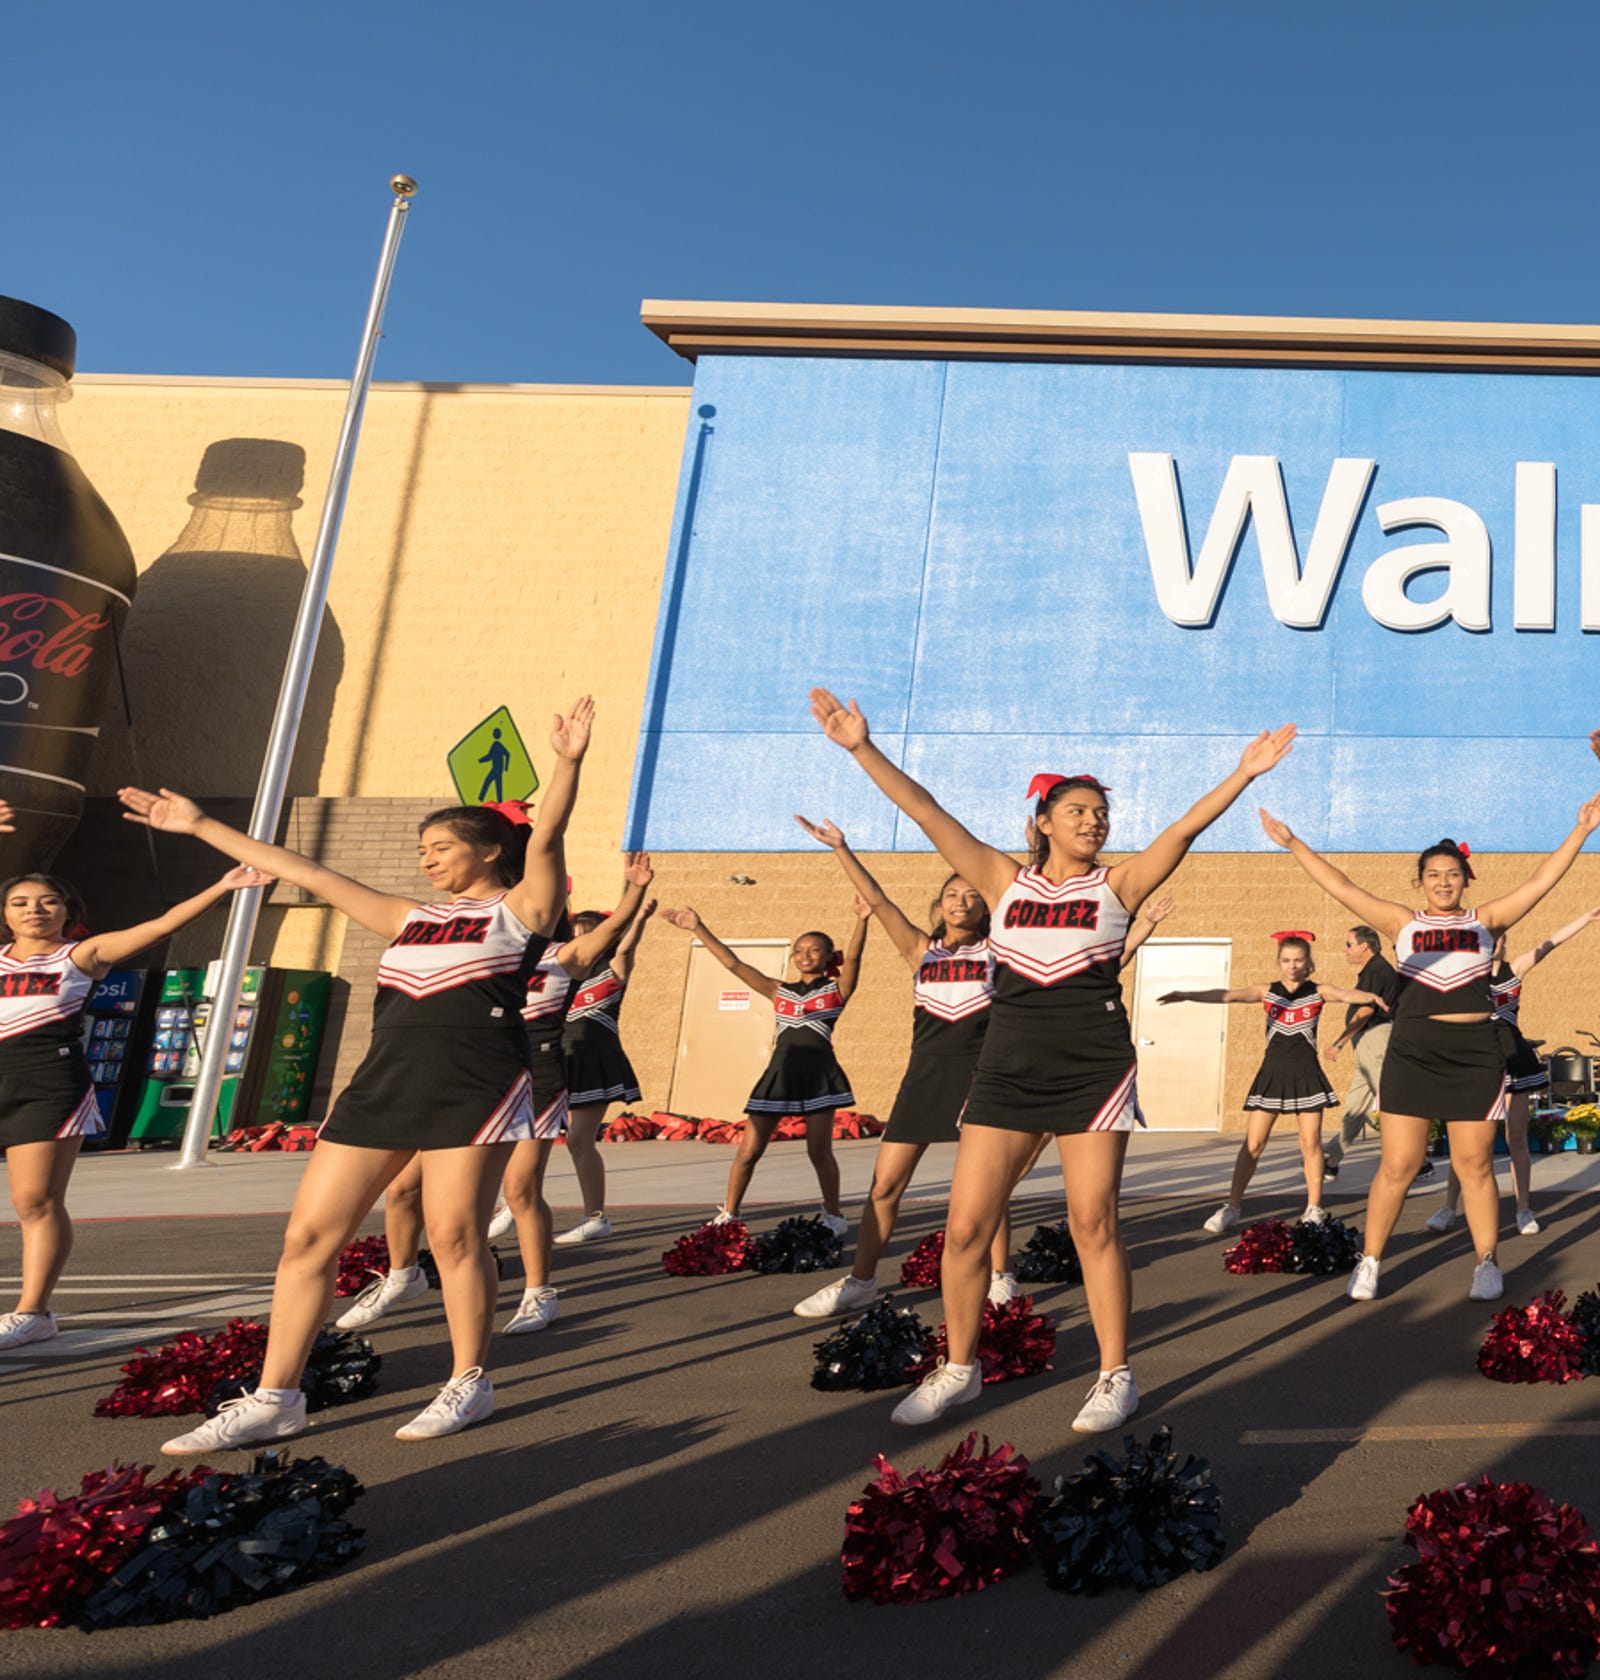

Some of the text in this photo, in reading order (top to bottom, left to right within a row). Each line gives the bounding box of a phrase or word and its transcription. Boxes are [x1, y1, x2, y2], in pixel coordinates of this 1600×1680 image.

[1004, 899, 1100, 931] CORTEZ
[1412, 928, 1480, 954] CORTEZ
[919, 960, 988, 984] CORTEZ
